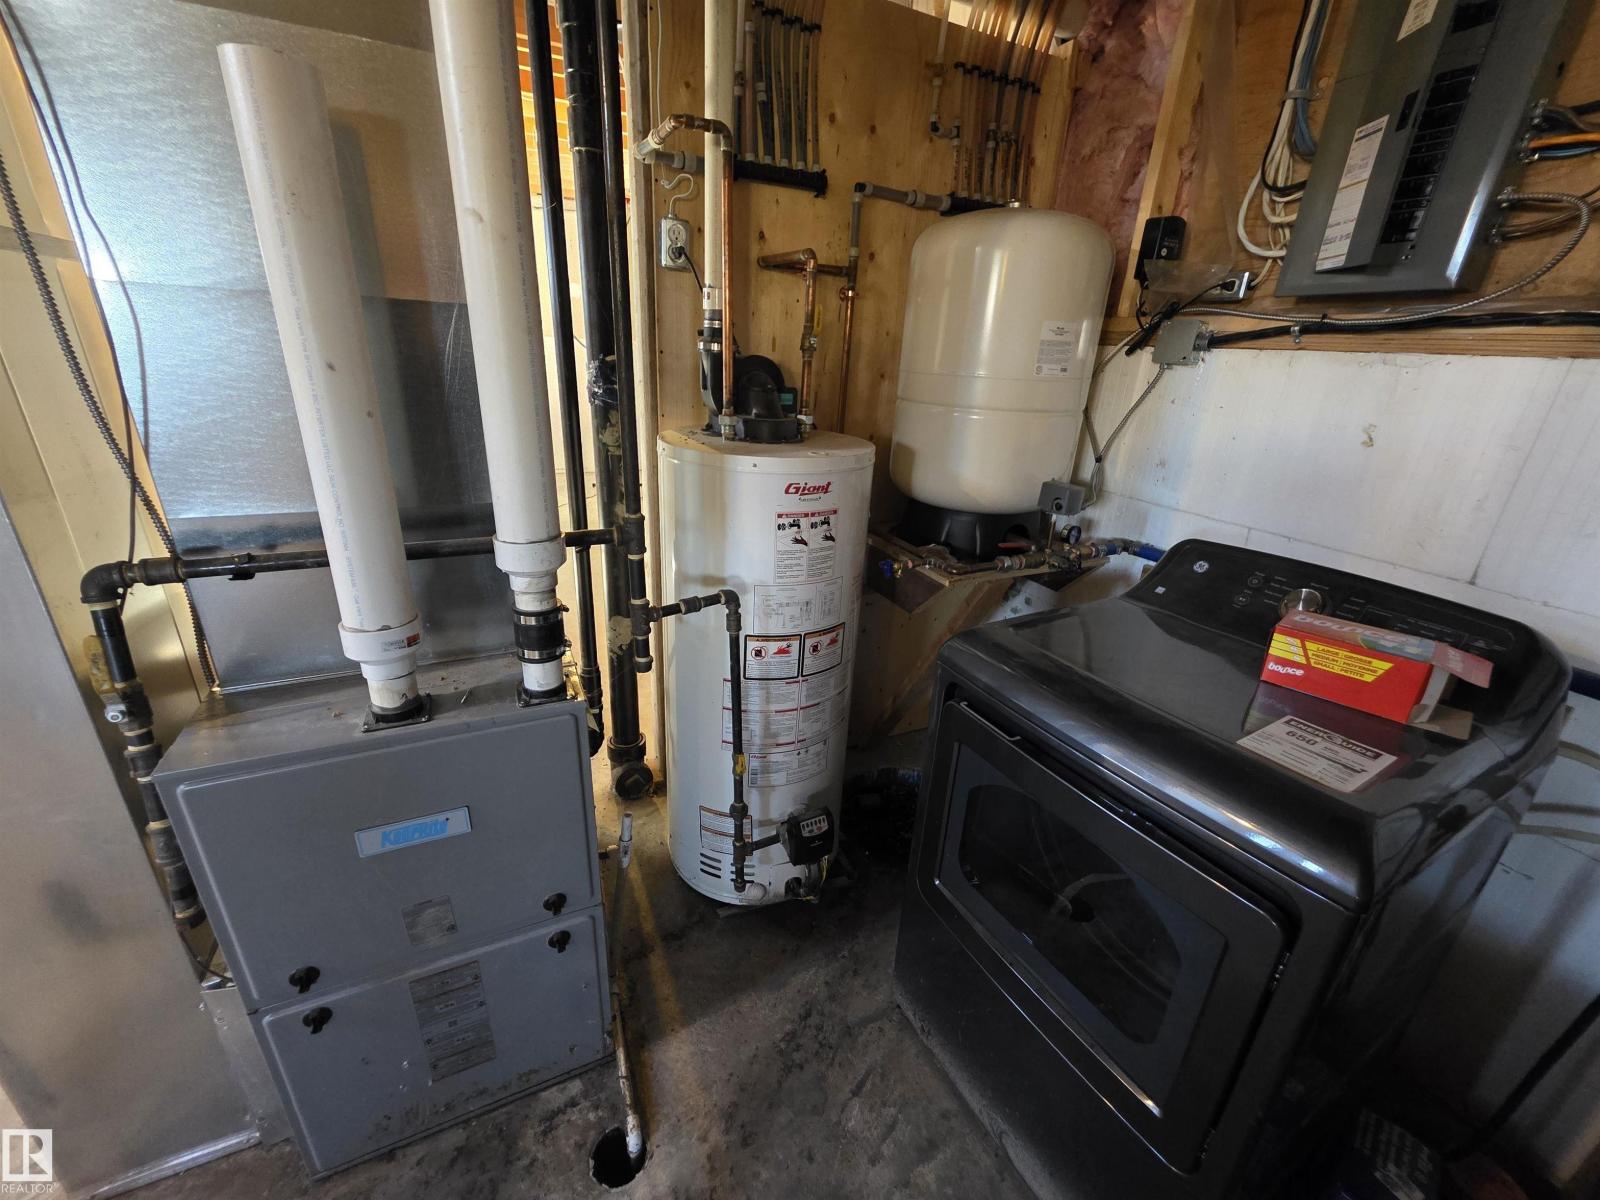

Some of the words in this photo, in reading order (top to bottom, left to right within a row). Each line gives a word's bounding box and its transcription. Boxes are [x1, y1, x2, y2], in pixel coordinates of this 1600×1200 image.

[784, 481, 832, 496] Giant
[1267, 661, 1305, 677] bounce
[1285, 730, 1317, 747] 650
